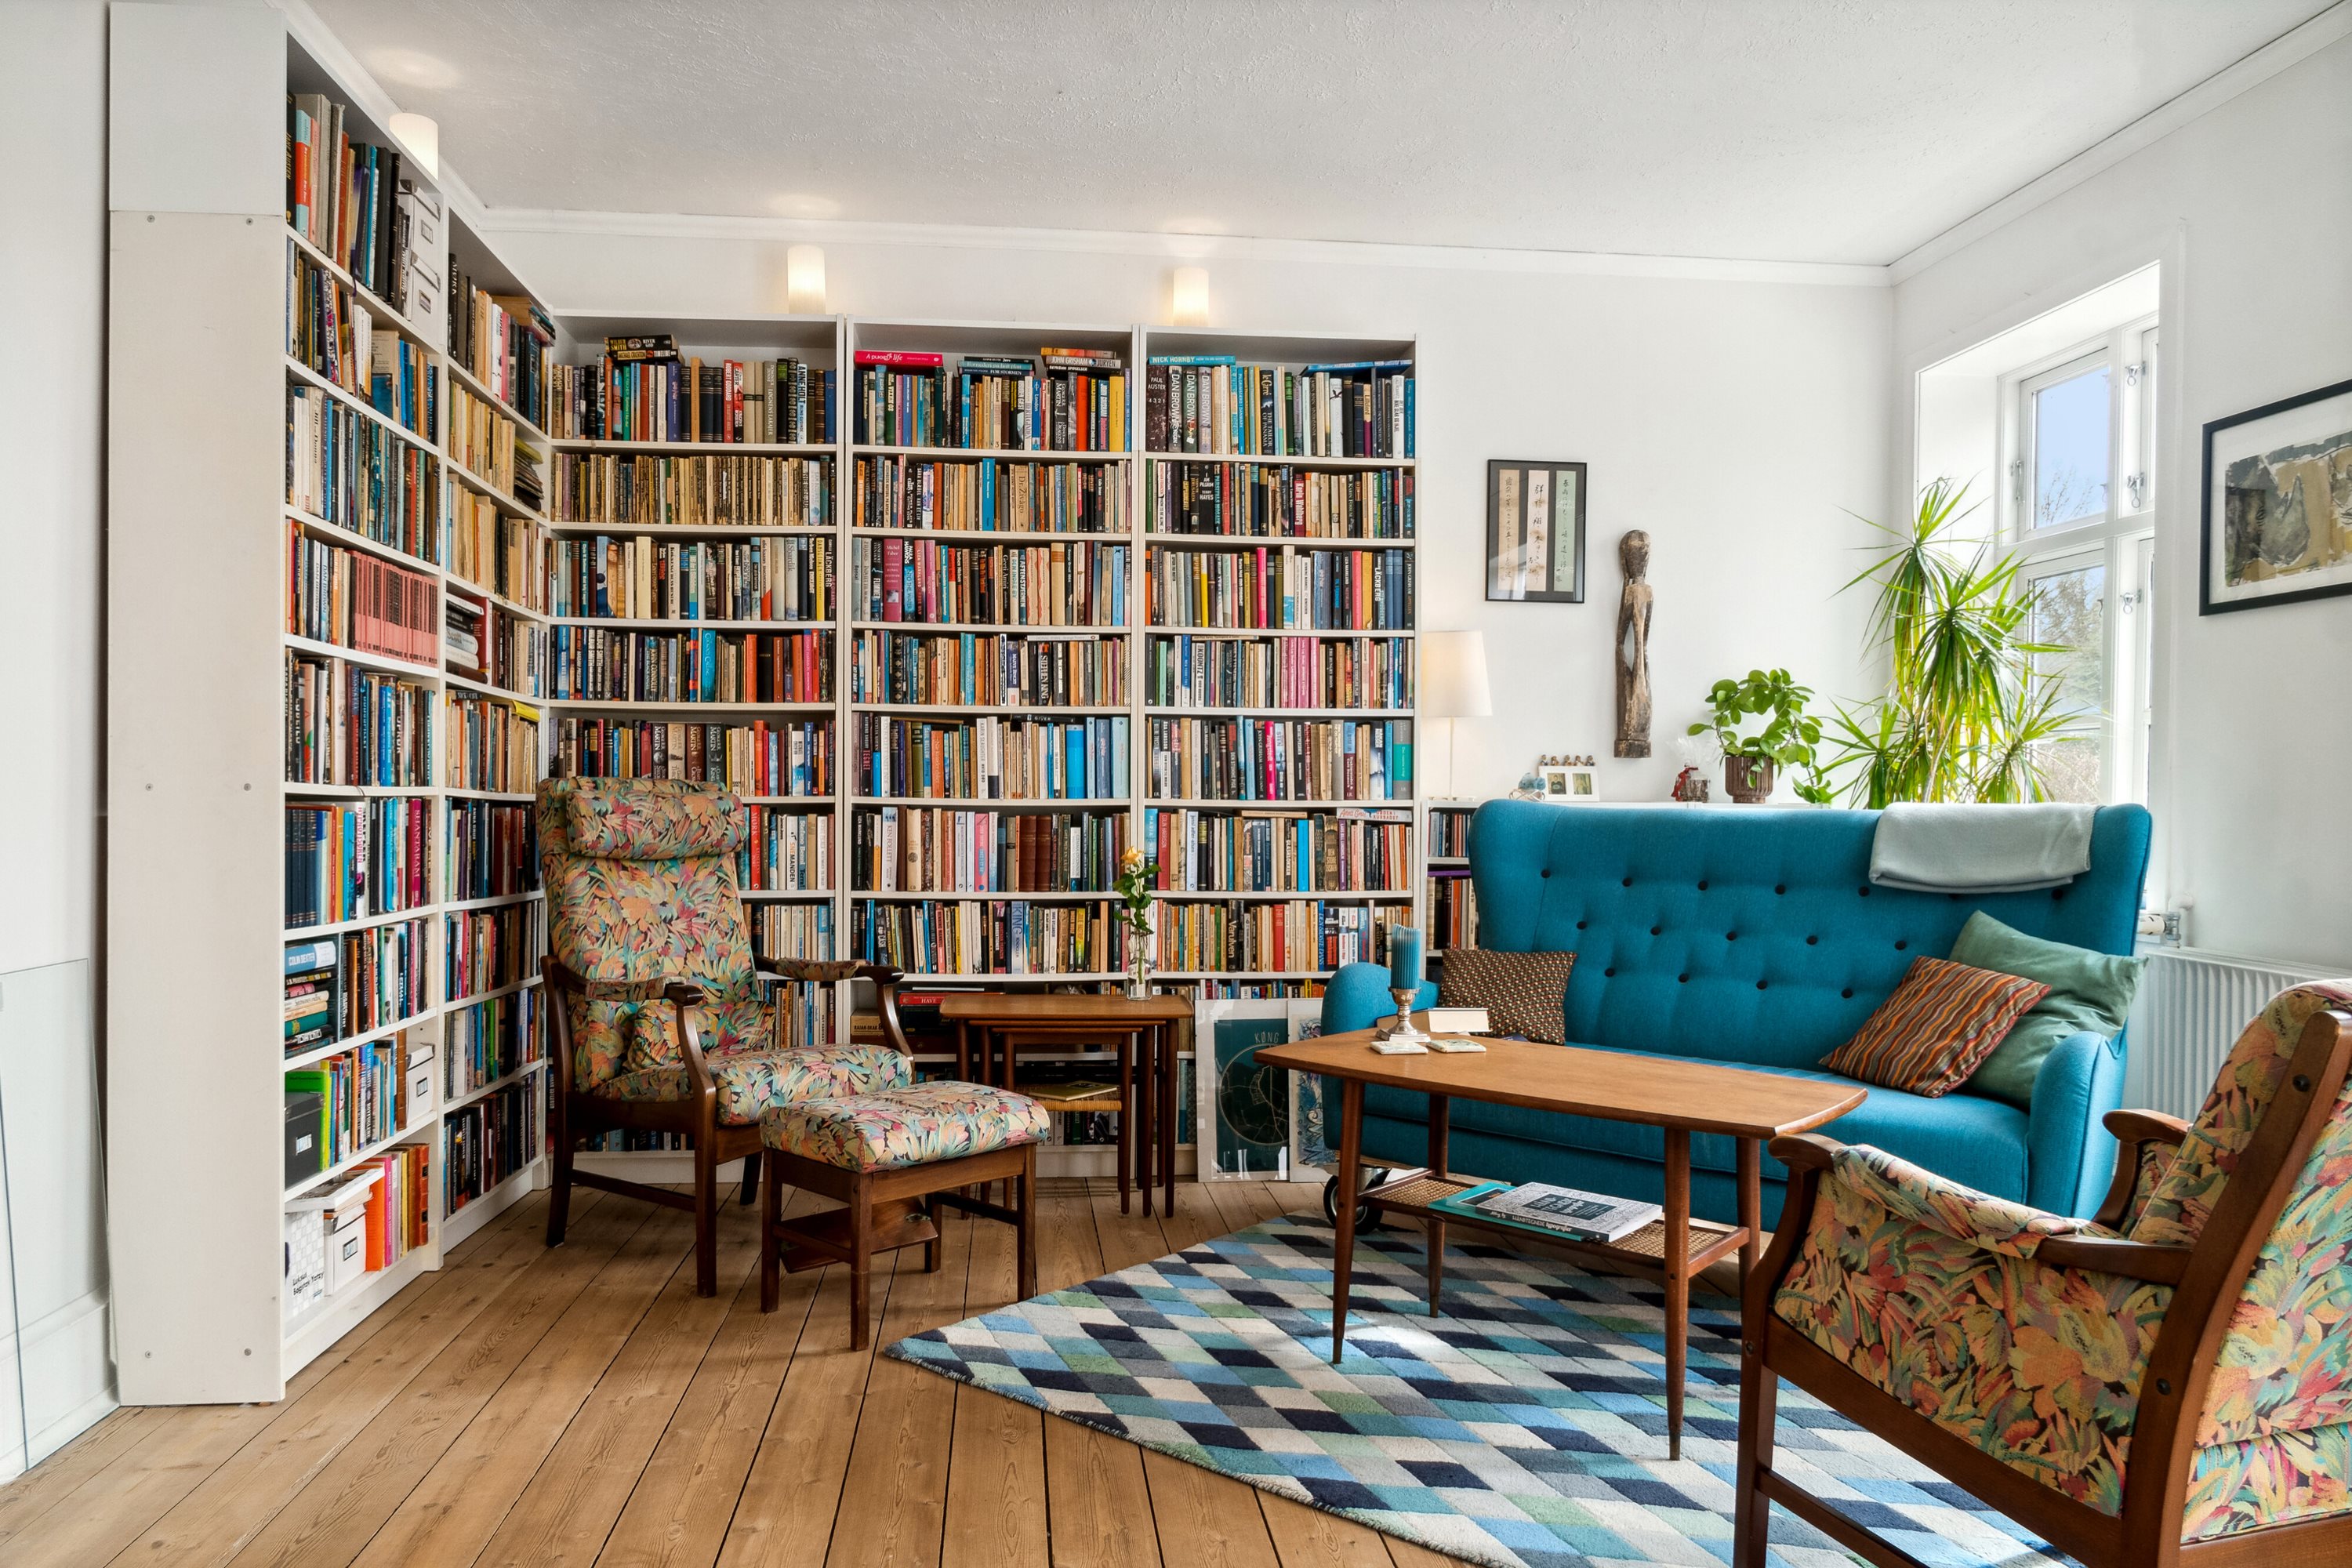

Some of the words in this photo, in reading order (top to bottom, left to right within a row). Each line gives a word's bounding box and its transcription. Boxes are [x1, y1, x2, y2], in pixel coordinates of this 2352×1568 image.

[893, 354, 902, 362] life
[1065, 357, 1088, 365] GRISHAM
[1261, 379, 1272, 395] Carré
[1012, 906, 1022, 934] KING
[1228, 920, 1237, 958] Varulven
